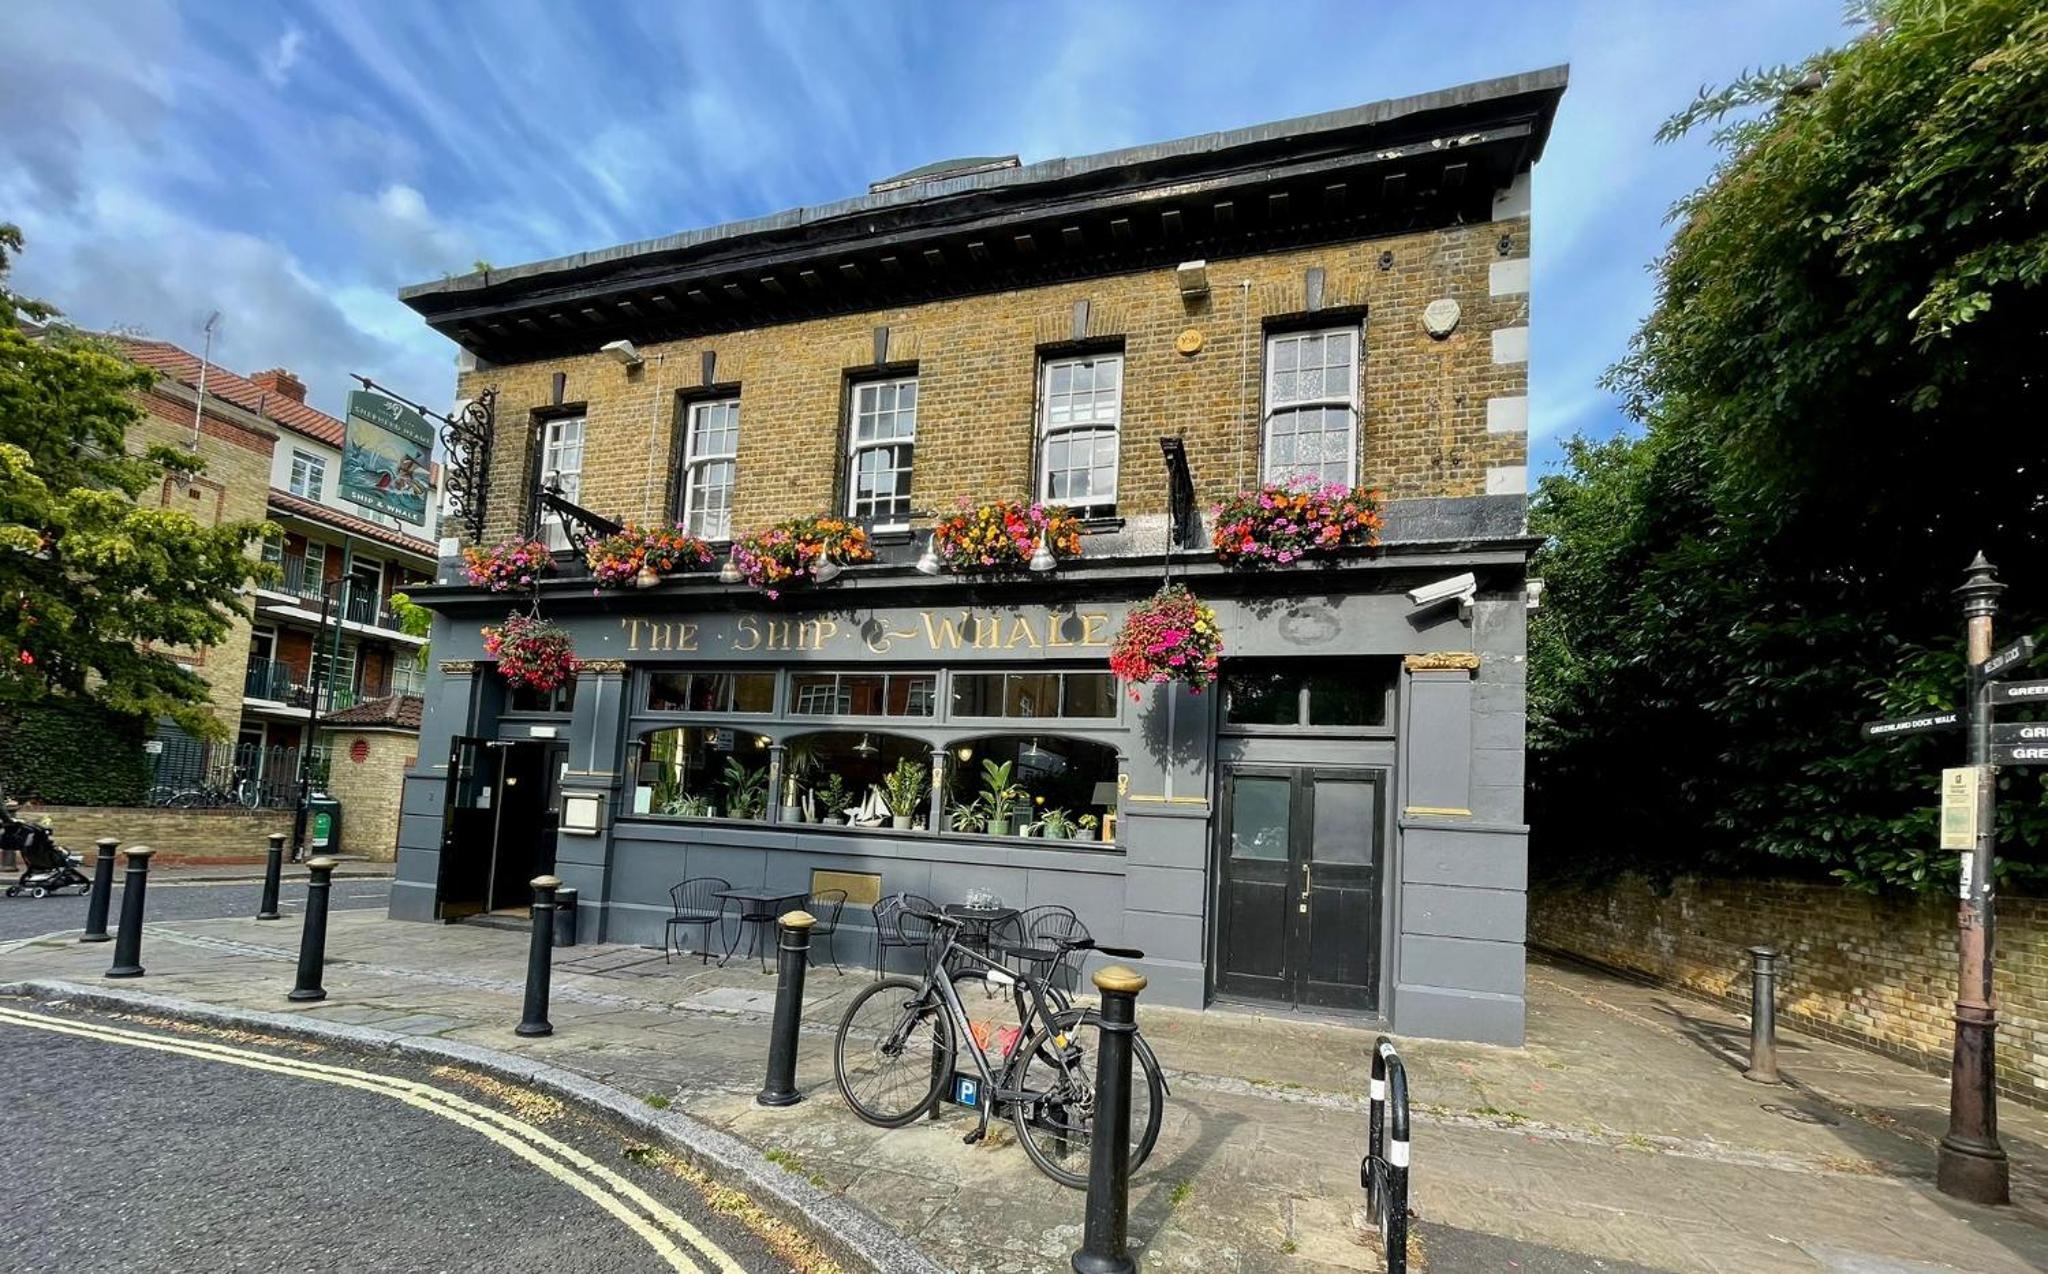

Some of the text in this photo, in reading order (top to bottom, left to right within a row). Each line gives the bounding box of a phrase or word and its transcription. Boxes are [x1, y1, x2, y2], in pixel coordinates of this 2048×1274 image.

[351, 491, 374, 504] SHIP
[387, 504, 418, 520] WHALE
[622, 617, 698, 651] THE
[731, 614, 837, 651] SHIP
[919, 610, 1110, 650] WHALE
[1870, 714, 1957, 734] GREENLAND DOCK WALK
[2020, 727, 2048, 738] GR
[961, 1082, 974, 1100] P
